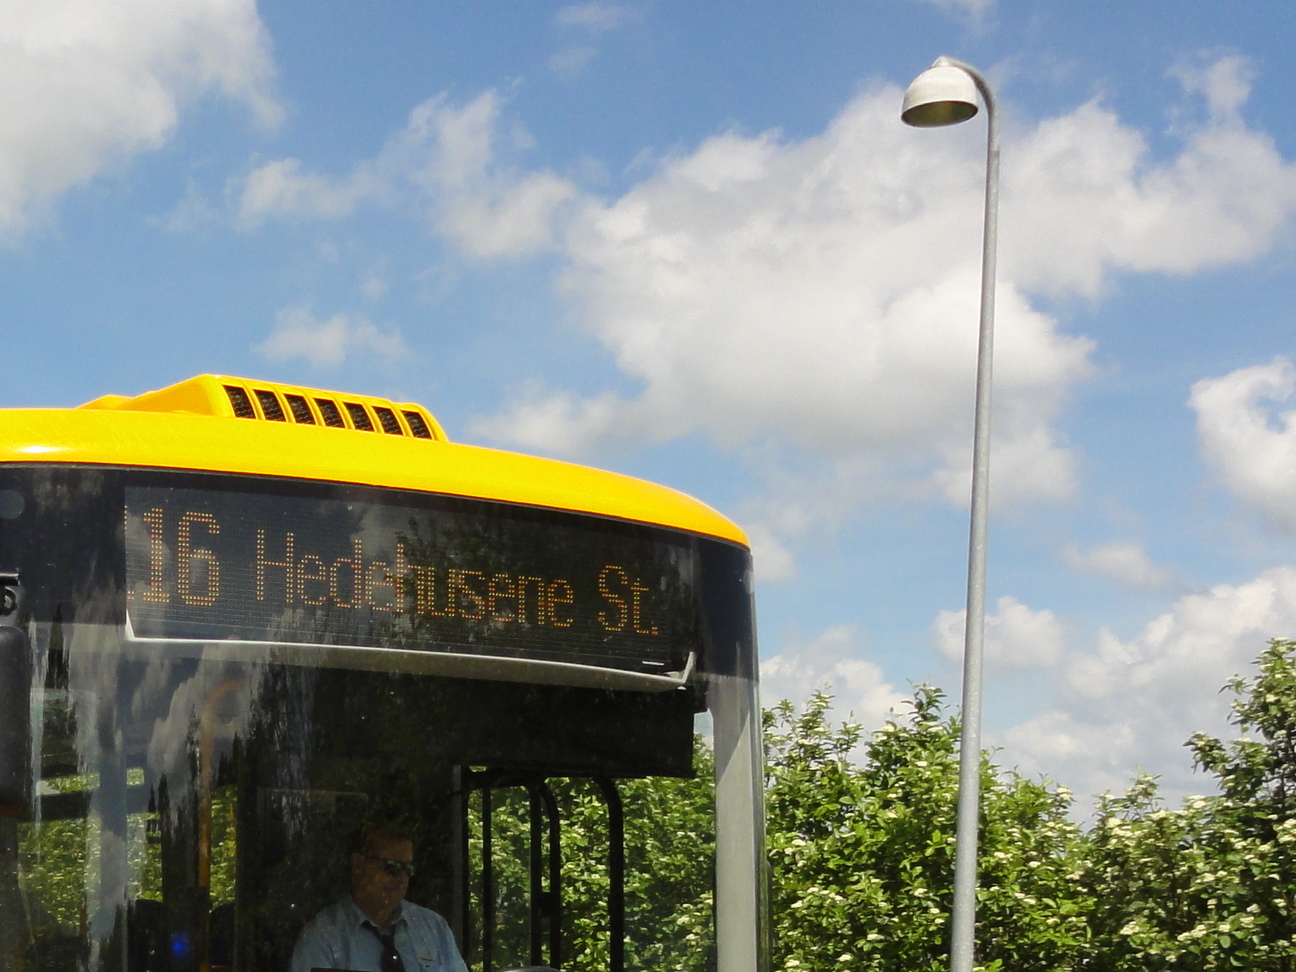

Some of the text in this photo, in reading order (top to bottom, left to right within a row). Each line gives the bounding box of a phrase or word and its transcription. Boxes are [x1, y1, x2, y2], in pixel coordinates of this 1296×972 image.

[124, 505, 659, 636] 16 Hedehusene St.
